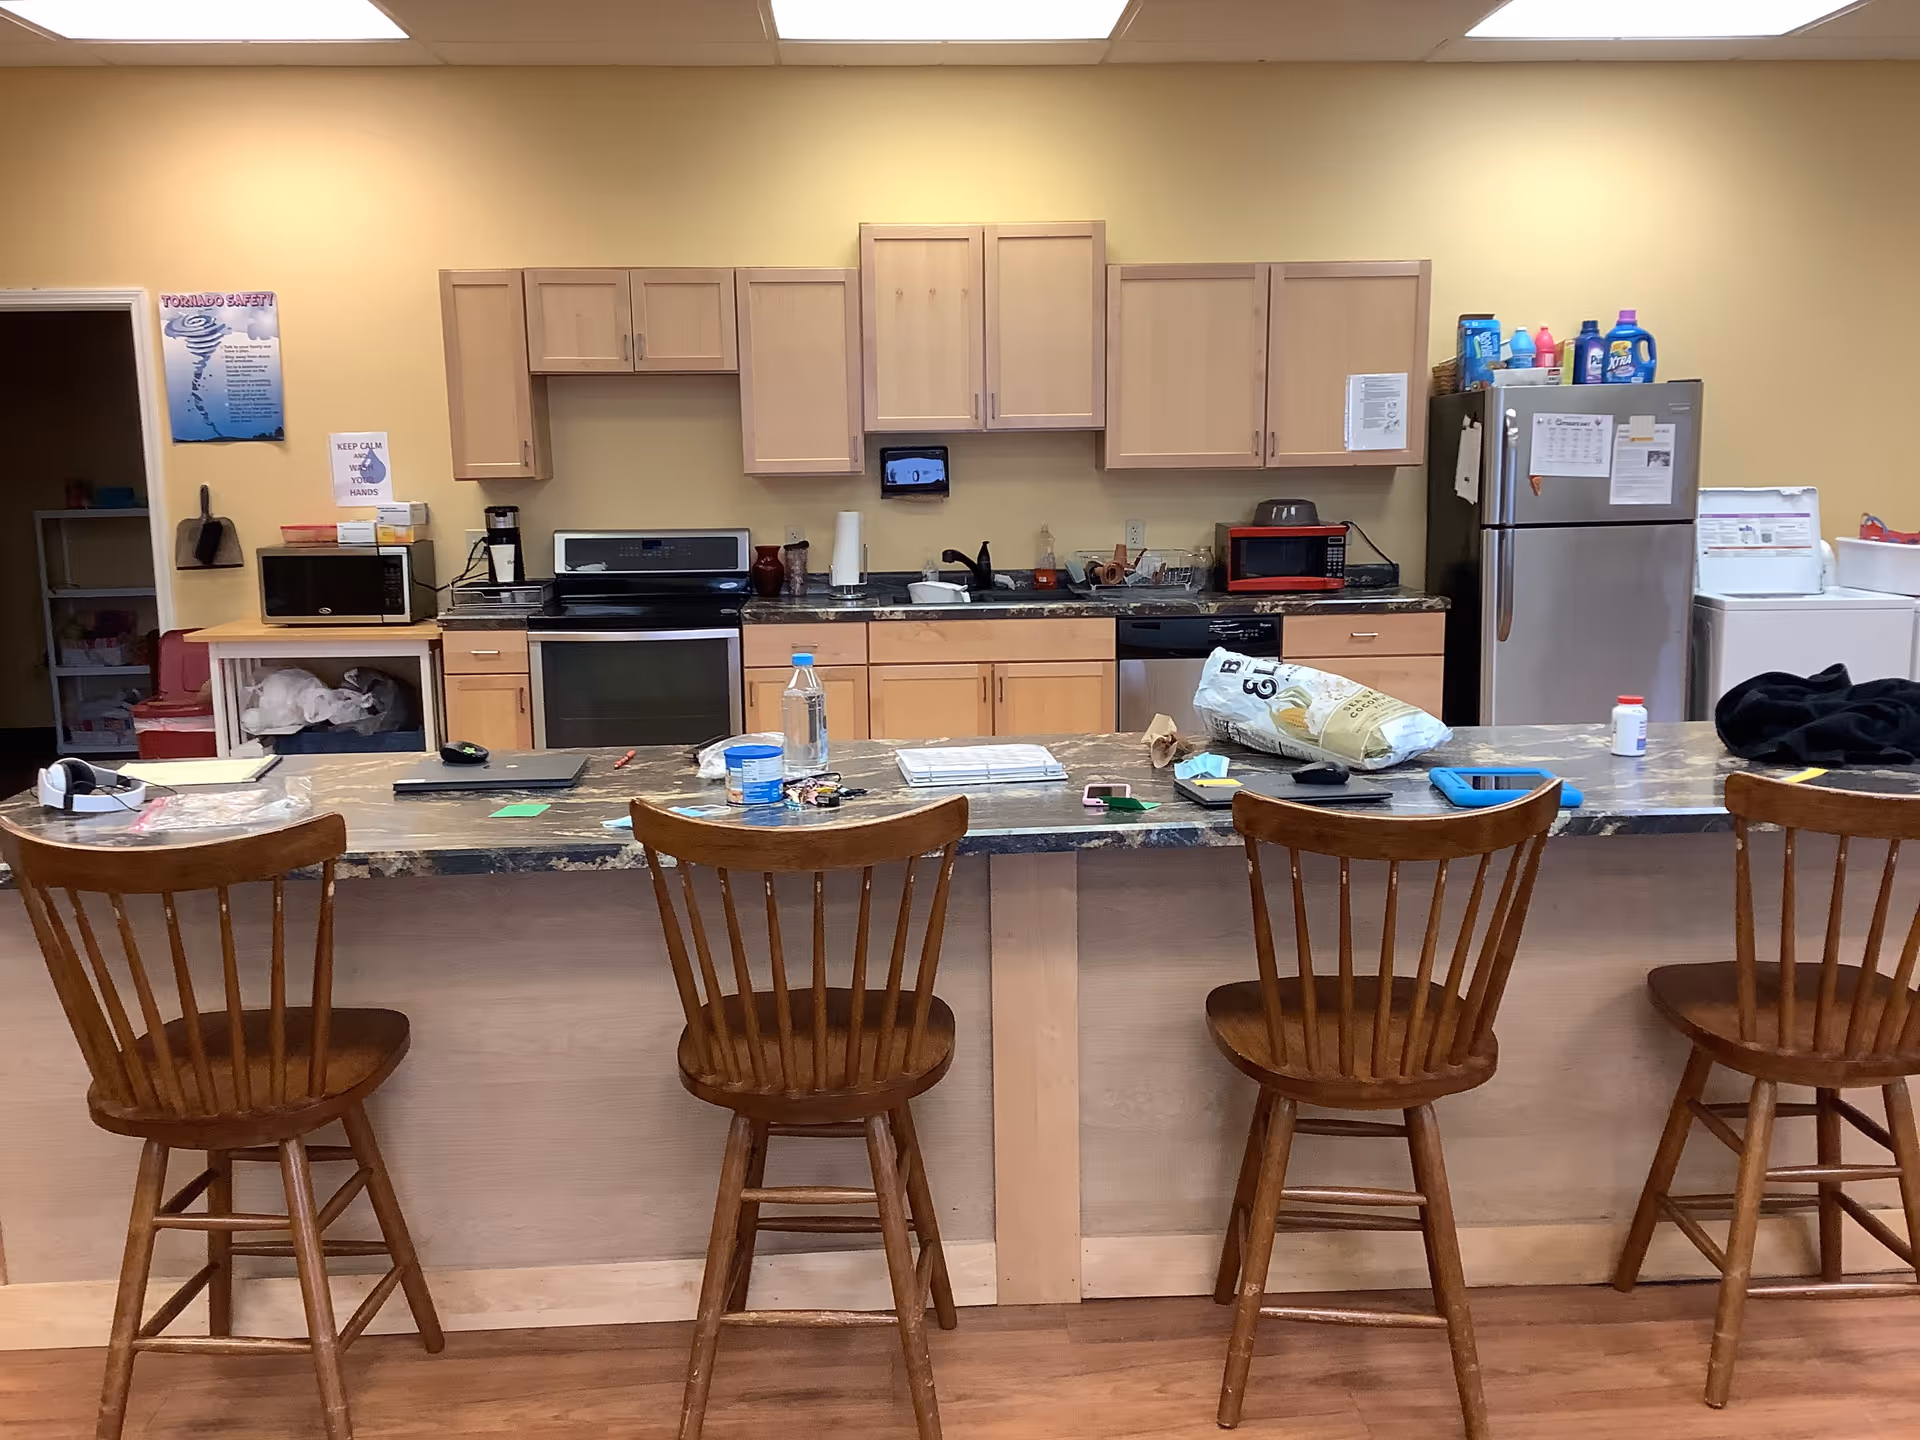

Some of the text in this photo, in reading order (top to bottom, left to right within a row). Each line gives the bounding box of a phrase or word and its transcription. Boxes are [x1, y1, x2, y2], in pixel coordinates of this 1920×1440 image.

[161, 293, 273, 308] TORNADO SAFETY
[1607, 354, 1632, 371] XTRA
[336, 441, 383, 451] KEEP CALM
[348, 463, 374, 472] WASH
[350, 476, 375, 485] YOUR
[349, 488, 379, 497] HANDS
[1342, 699, 1361, 712] SEA
